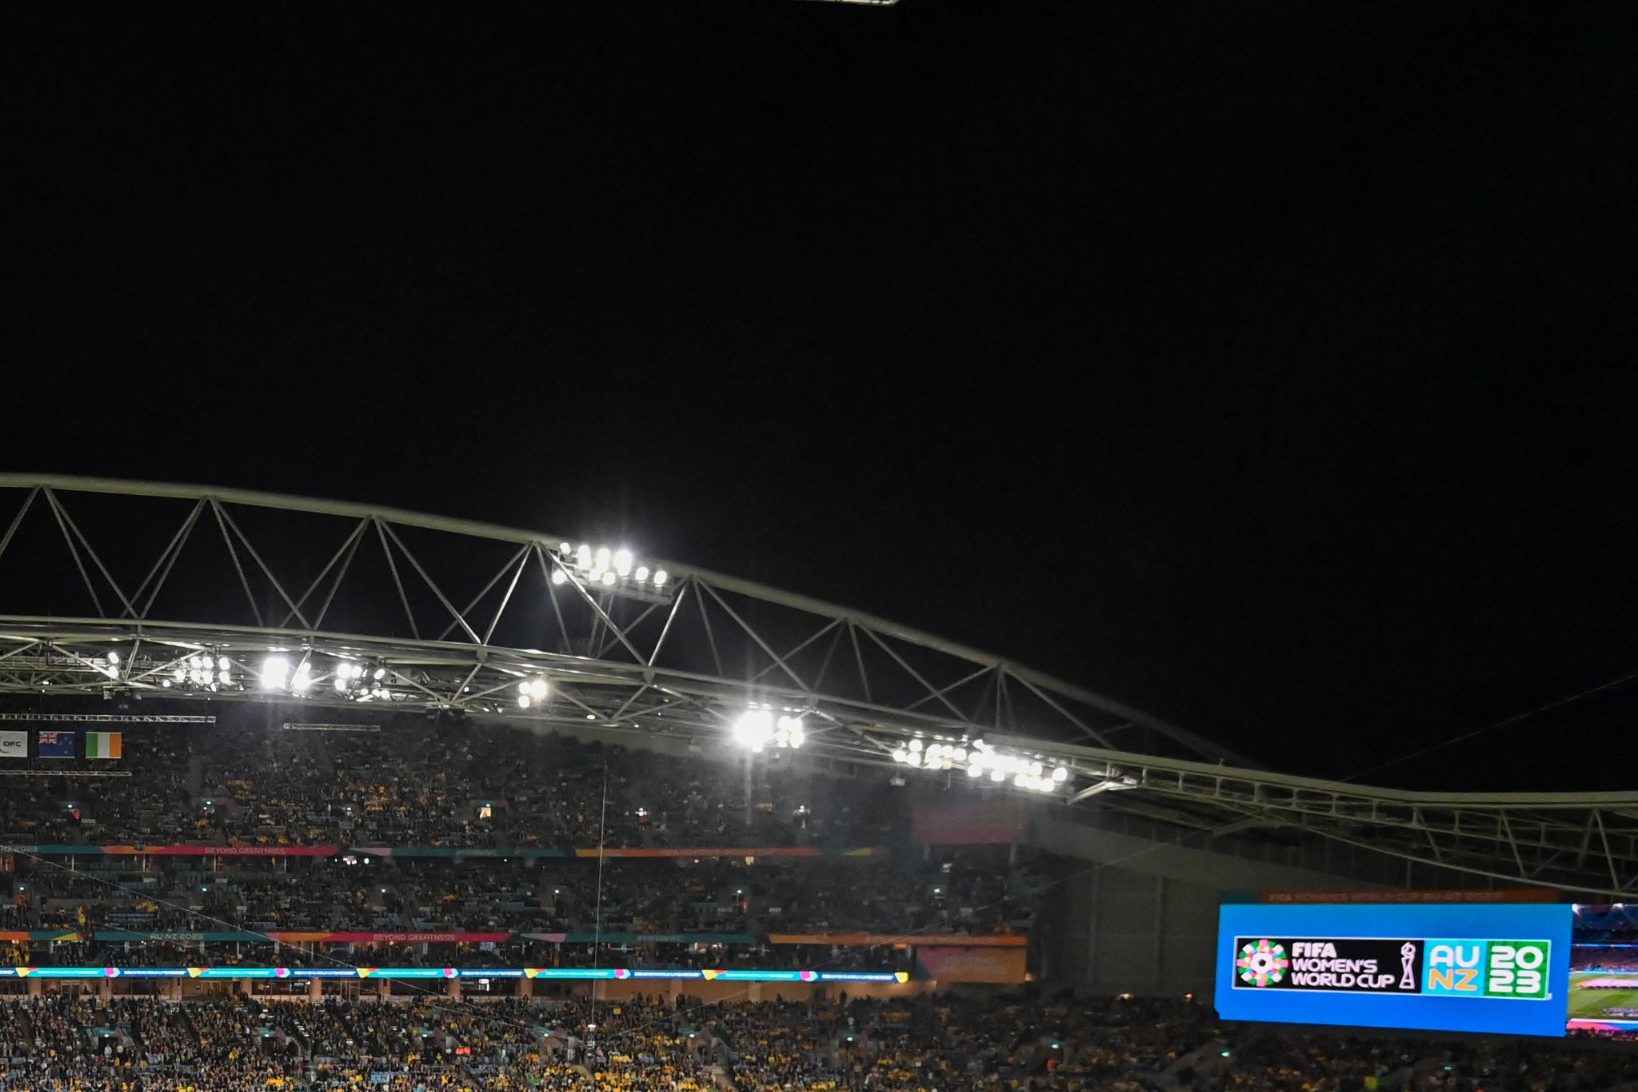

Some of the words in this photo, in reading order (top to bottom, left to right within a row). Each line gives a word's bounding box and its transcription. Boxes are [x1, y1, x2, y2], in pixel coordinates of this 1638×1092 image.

[1292, 942, 1337, 959] FIFA
[1429, 945, 1481, 968] AU
[1490, 946, 1544, 969] 20
[1292, 958, 1378, 973] WOMEN'S
[1291, 973, 1355, 988] WORLD
[1356, 974, 1395, 989] CUP
[1429, 968, 1478, 991] NZ
[1490, 969, 1542, 993] 23
